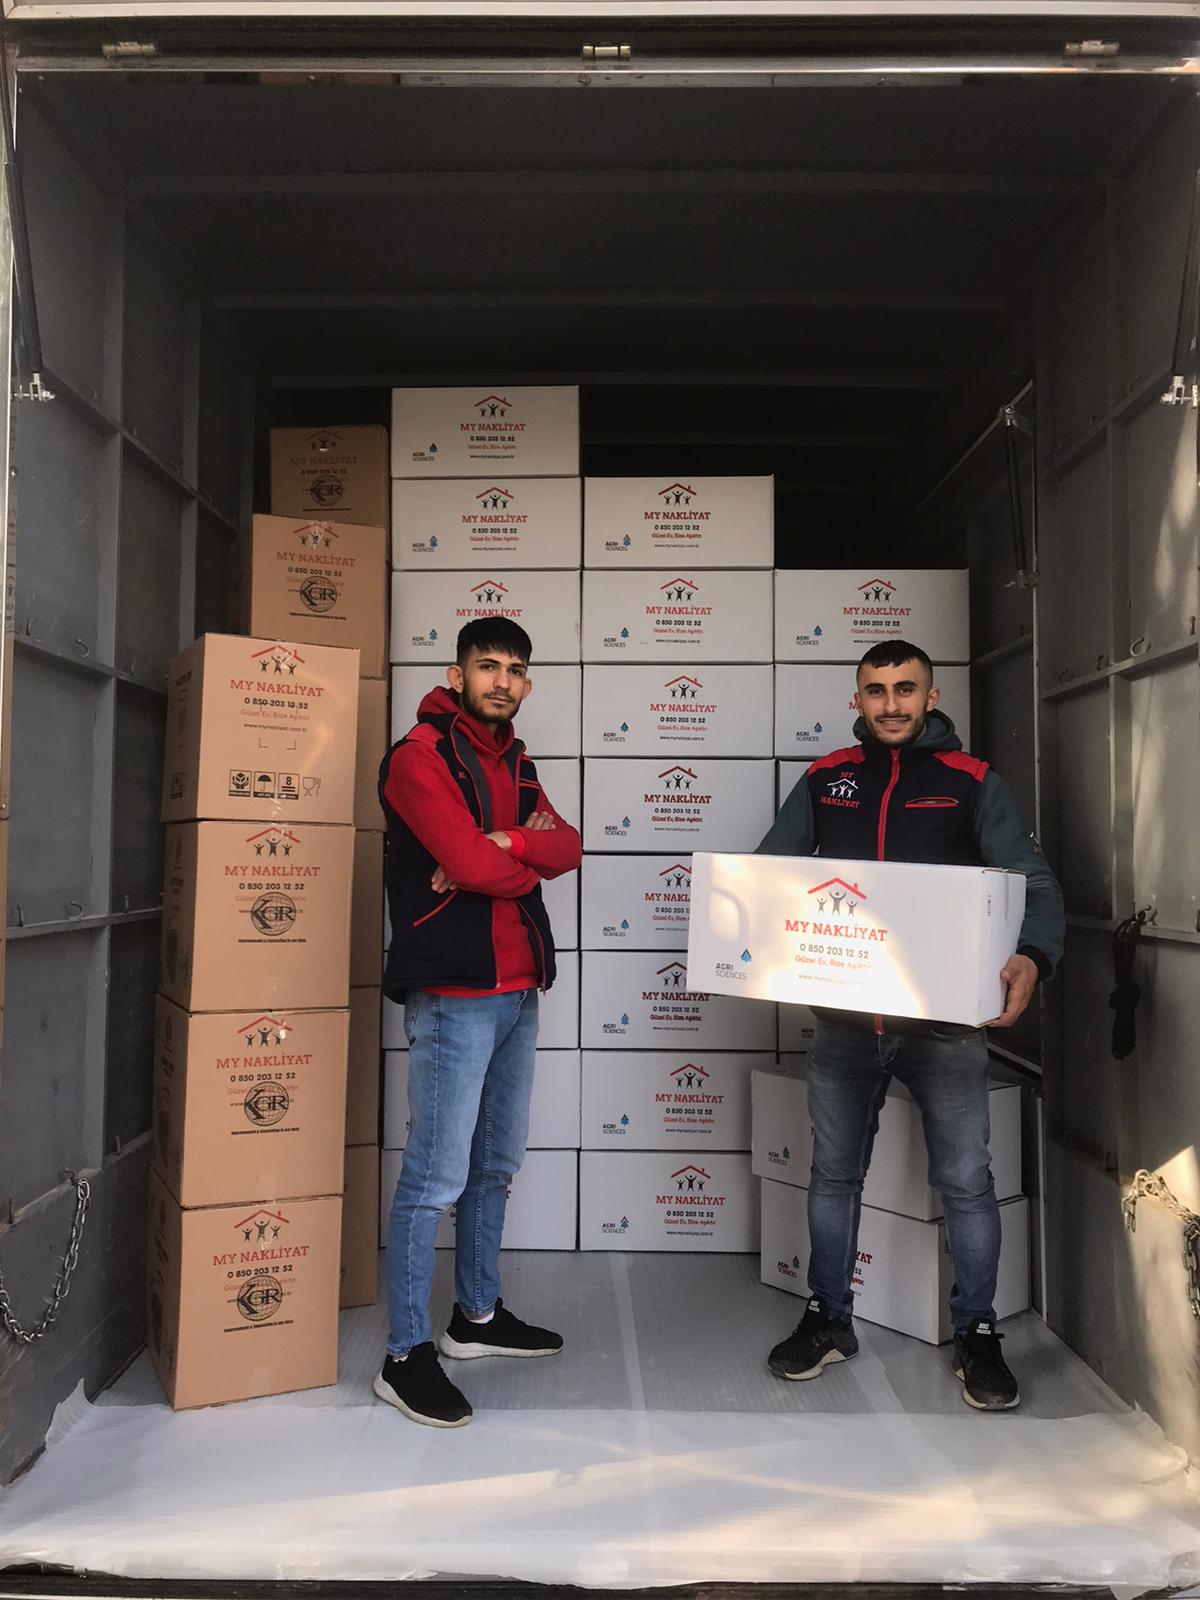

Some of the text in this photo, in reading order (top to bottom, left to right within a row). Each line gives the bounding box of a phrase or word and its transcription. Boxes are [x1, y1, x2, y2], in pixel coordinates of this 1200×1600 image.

[460, 421, 526, 431] MY NAKLİYAT
[462, 513, 528, 523] MY NAKLİYAT
[644, 510, 711, 520] MY NAKLİYAT
[275, 552, 296, 561] MY
[455, 608, 472, 616] MY
[645, 605, 713, 615] MY NAKLİYAT
[843, 605, 911, 616] MY NAKLİYAT
[230, 679, 325, 697] MY NAKLİYAT
[298, 702, 309, 710] 52
[650, 702, 717, 713] MY NAKLİYAT
[285, 776, 292, 785] 8
[644, 793, 712, 804] MY NAKLİYAT
[224, 864, 321, 878] MY NAKLİYAT
[644, 893, 662, 901] MY
[784, 920, 887, 943] MY NAKLİYAT
[800, 943, 806, 951] 0
[846, 948, 855, 956] 12
[858, 949, 869, 958] 52
[716, 971, 747, 980] SCIENCES
[642, 992, 659, 1000] MY
[215, 1052, 313, 1069] MY NAKLİYAT
[655, 1092, 724, 1104] MY NAKLİYAT
[656, 1194, 726, 1206] MY NAKLİYAT
[212, 1244, 310, 1266] MY NAKLİYAT
[236, 1269, 252, 1278] 850
[254, 1267, 270, 1276] 203
[283, 1264, 294, 1272] 52
